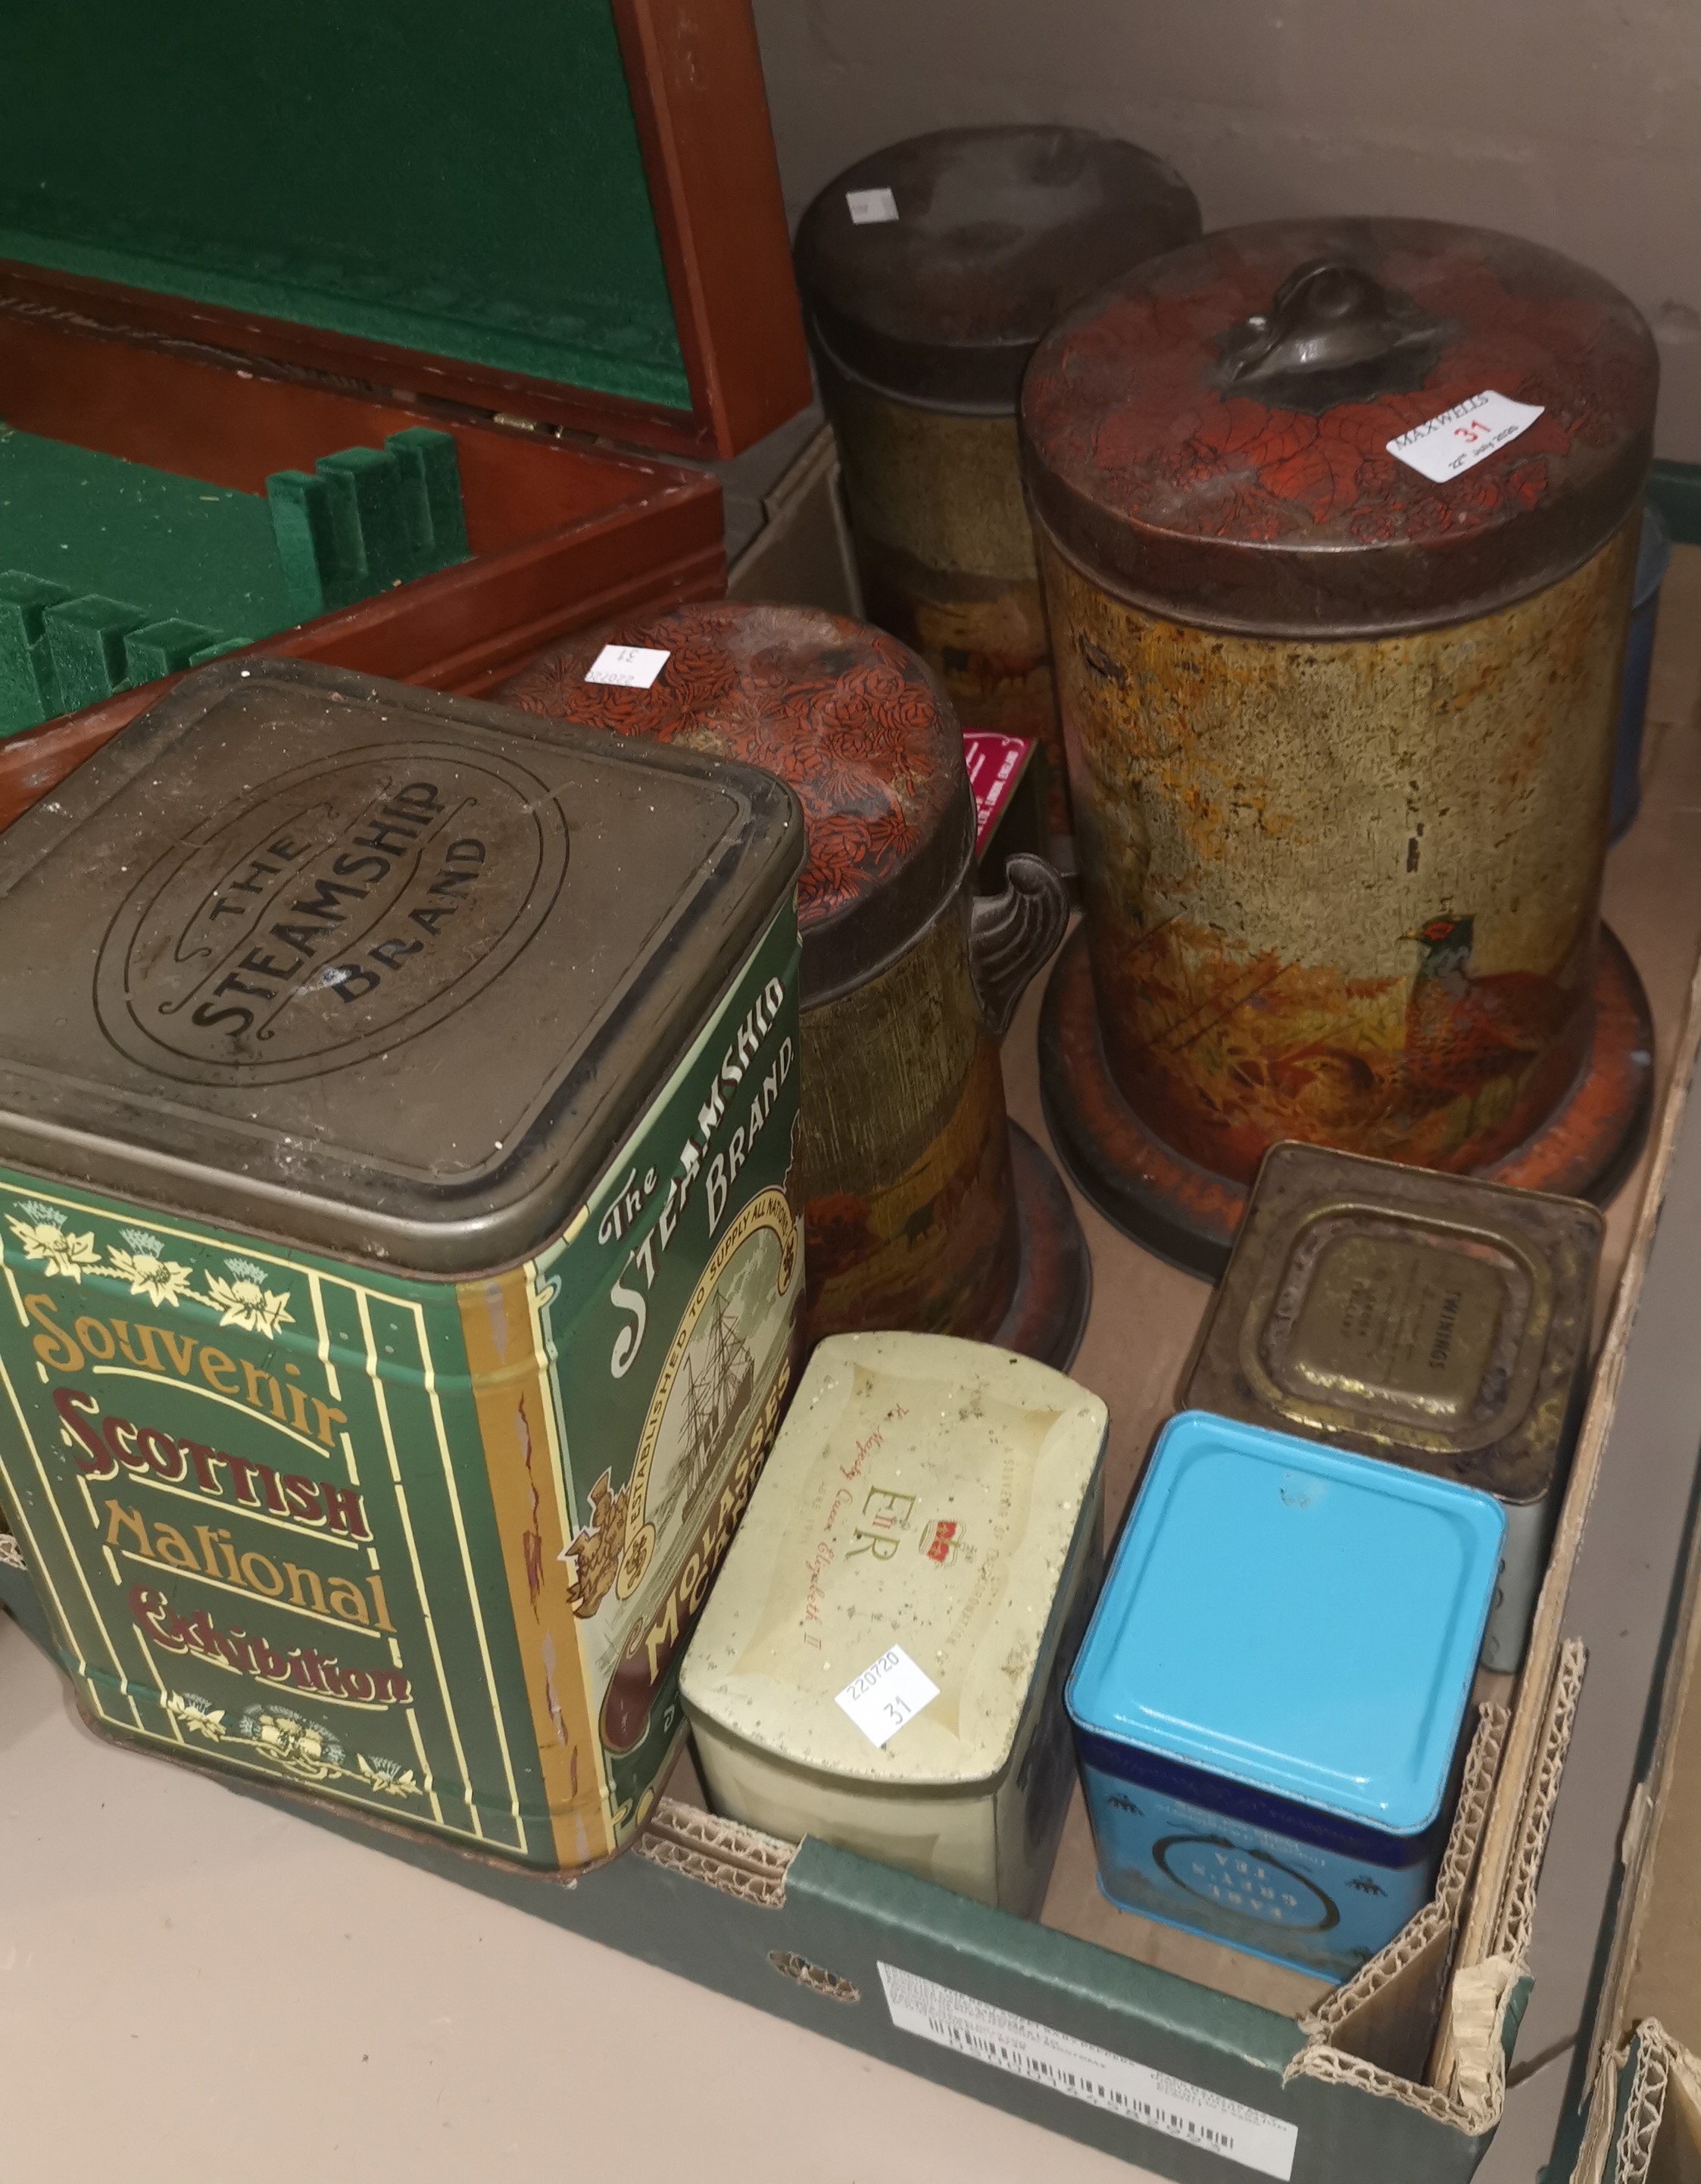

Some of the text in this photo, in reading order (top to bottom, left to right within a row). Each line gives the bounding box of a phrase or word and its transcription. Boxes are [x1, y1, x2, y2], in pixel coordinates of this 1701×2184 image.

[1394, 395, 1489, 451] MAXWELLS
[1453, 420, 1491, 443] 31
[192, 782, 444, 1037] STEAMSHIP
[209, 837, 312, 922] THE
[330, 836, 487, 1004] BRAND
[598, 1166, 657, 1246] The
[610, 975, 785, 1380] STEAMSHIP
[24, 1292, 348, 1450] Souvenir
[631, 1328, 688, 1521] ESTABLISHED
[689, 1287, 707, 1319] TO
[709, 1216, 749, 1281] SUPPLY
[750, 1203, 766, 1225] ALL
[1428, 1290, 1462, 1369] TWININGS
[52, 1385, 372, 1542] SCOTTISH
[645, 1358, 792, 1686] MOLASSES
[103, 1498, 398, 1634] National
[805, 1542, 835, 1625] Elizabeth
[129, 1583, 414, 1706] Exhibition
[846, 1651, 899, 1702] 220720
[883, 1696, 912, 1725] 31
